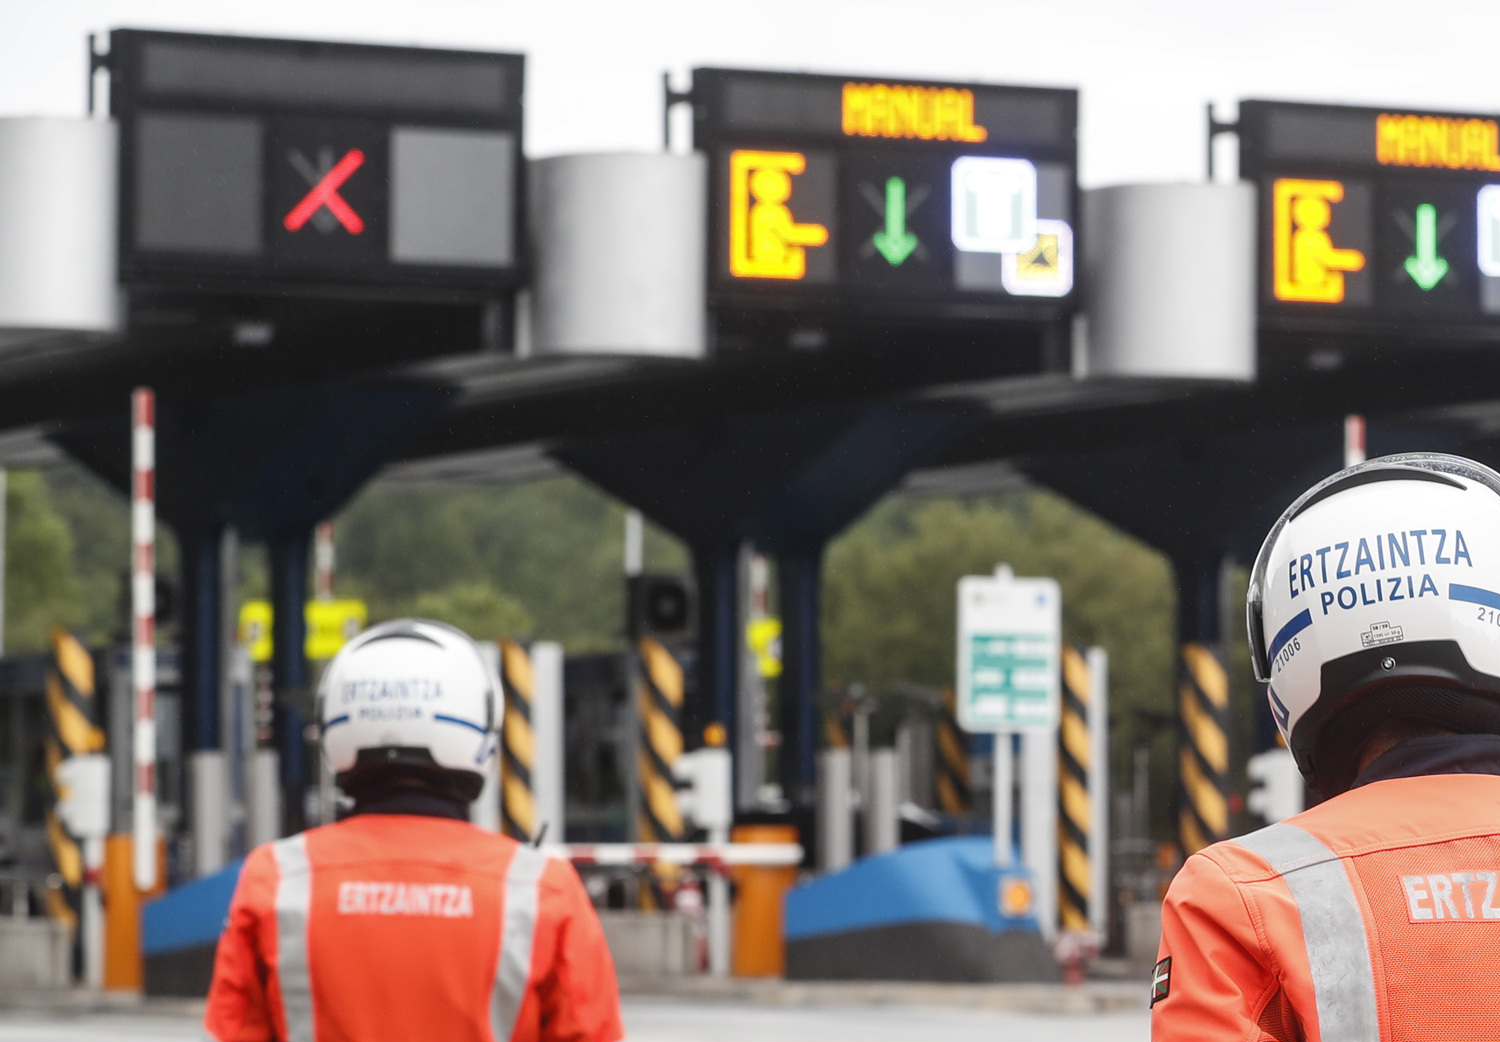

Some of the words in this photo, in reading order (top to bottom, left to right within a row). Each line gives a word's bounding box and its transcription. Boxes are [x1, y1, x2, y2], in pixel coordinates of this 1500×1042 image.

[842, 82, 988, 143] MANUAL
[1288, 529, 1473, 600] ERTZAINTZA
[1320, 573, 1440, 615] POLIZIA
[1275, 637, 1301, 673] 21006
[342, 677, 444, 705] ERTZAINTZA
[357, 705, 424, 722] POLIZIA
[338, 881, 474, 919] ERTZAINTZA
